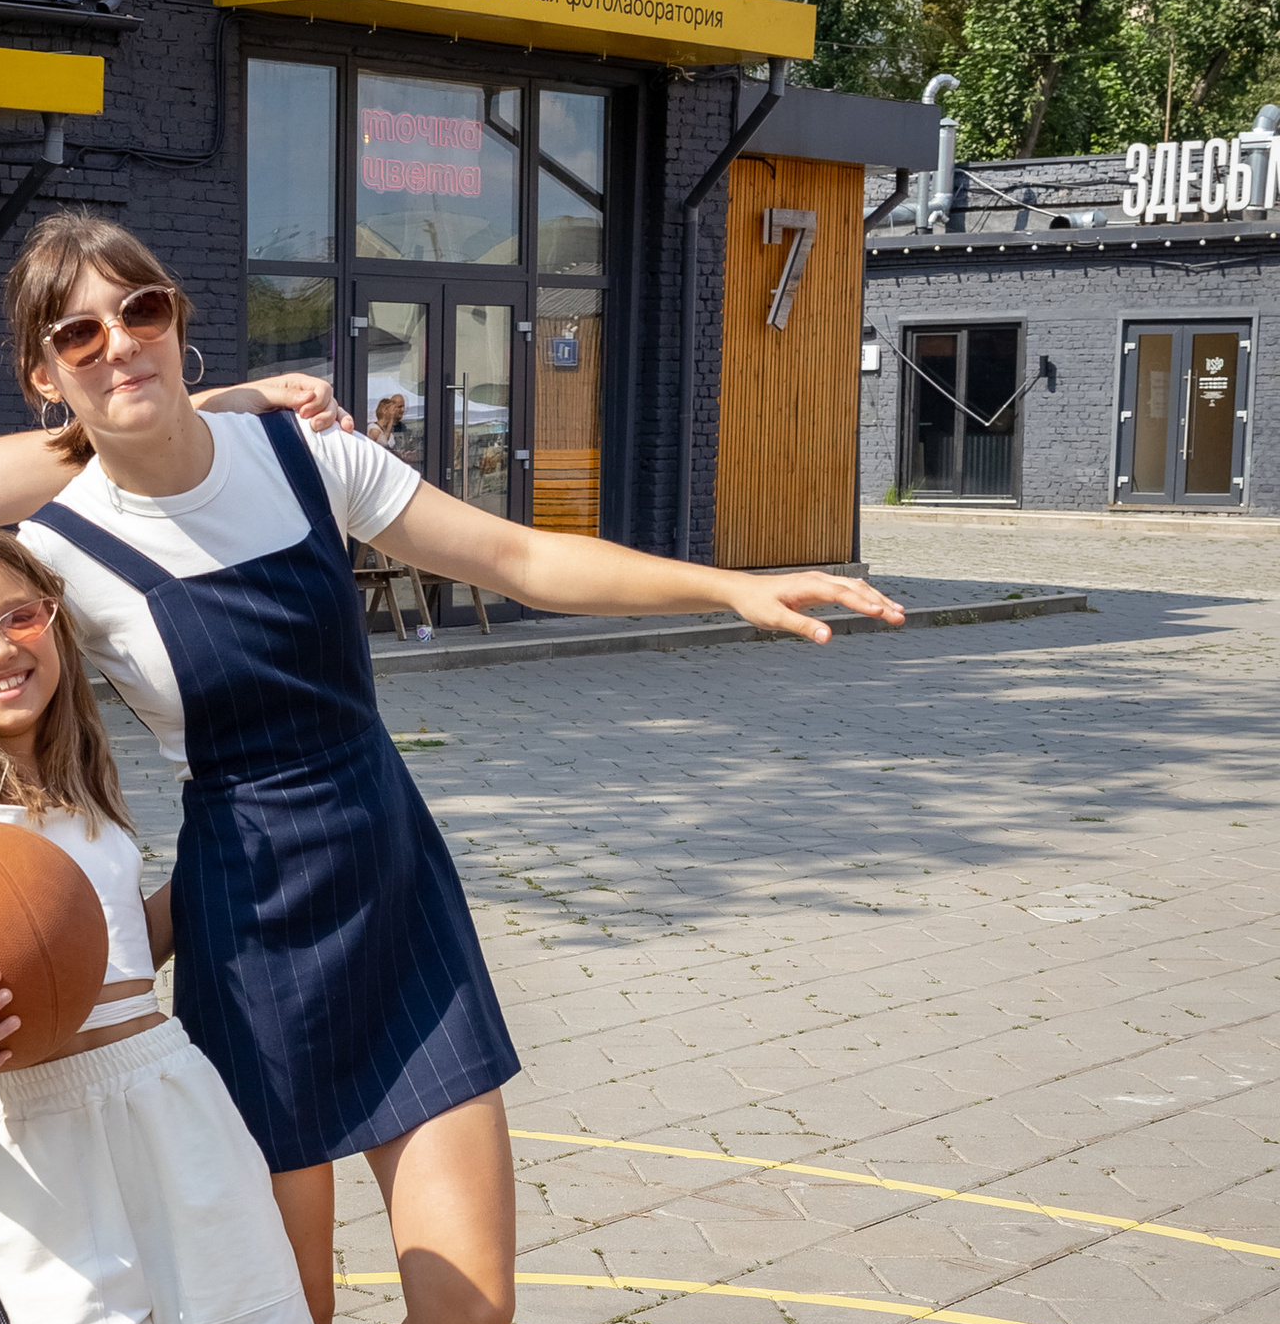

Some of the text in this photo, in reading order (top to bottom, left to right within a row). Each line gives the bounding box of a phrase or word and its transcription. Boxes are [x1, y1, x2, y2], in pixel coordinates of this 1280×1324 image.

[362, 108, 482, 150] точка
[362, 155, 482, 197] цвета
[1122, 137, 1253, 223] ЗДЕСЬ
[763, 208, 817, 332] 7
